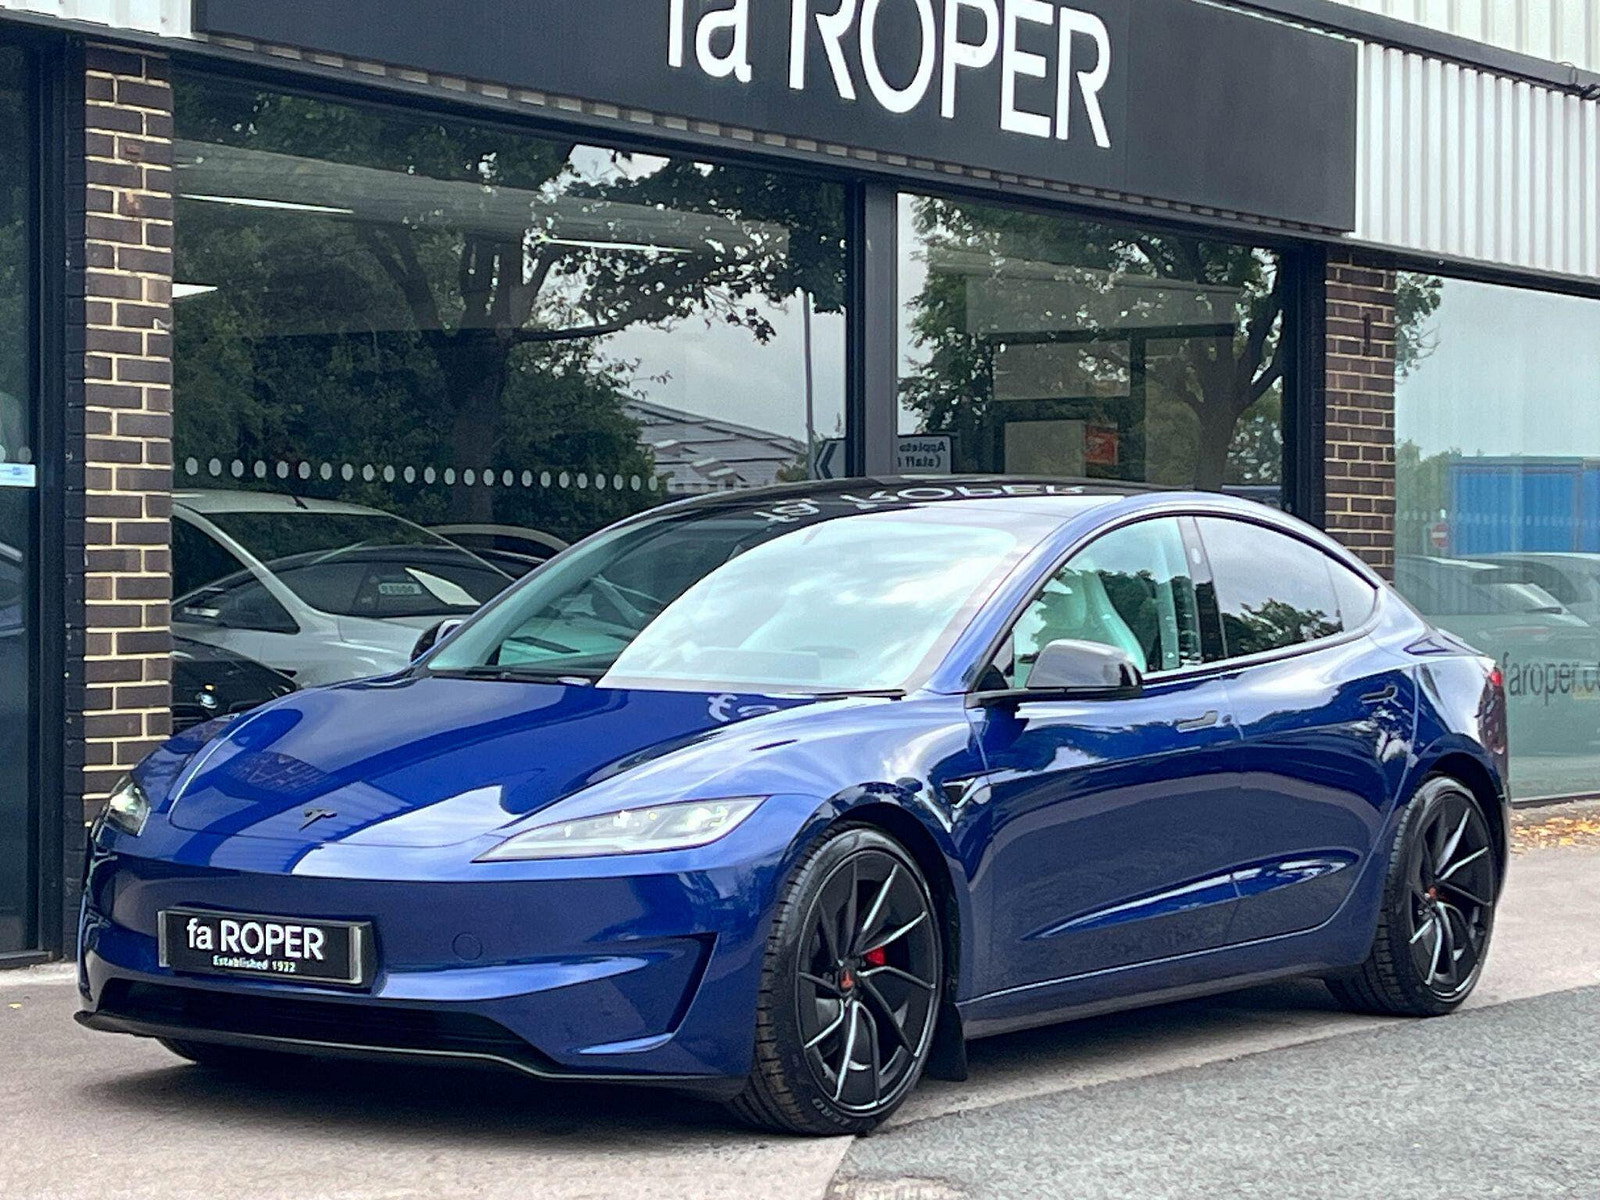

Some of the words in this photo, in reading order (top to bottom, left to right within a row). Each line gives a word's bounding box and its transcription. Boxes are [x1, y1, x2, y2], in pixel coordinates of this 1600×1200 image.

[789, 0, 1111, 148] ROPER
[187, 918, 213, 949] fa
[220, 919, 323, 960] ROPER
[213, 954, 268, 970] Established
